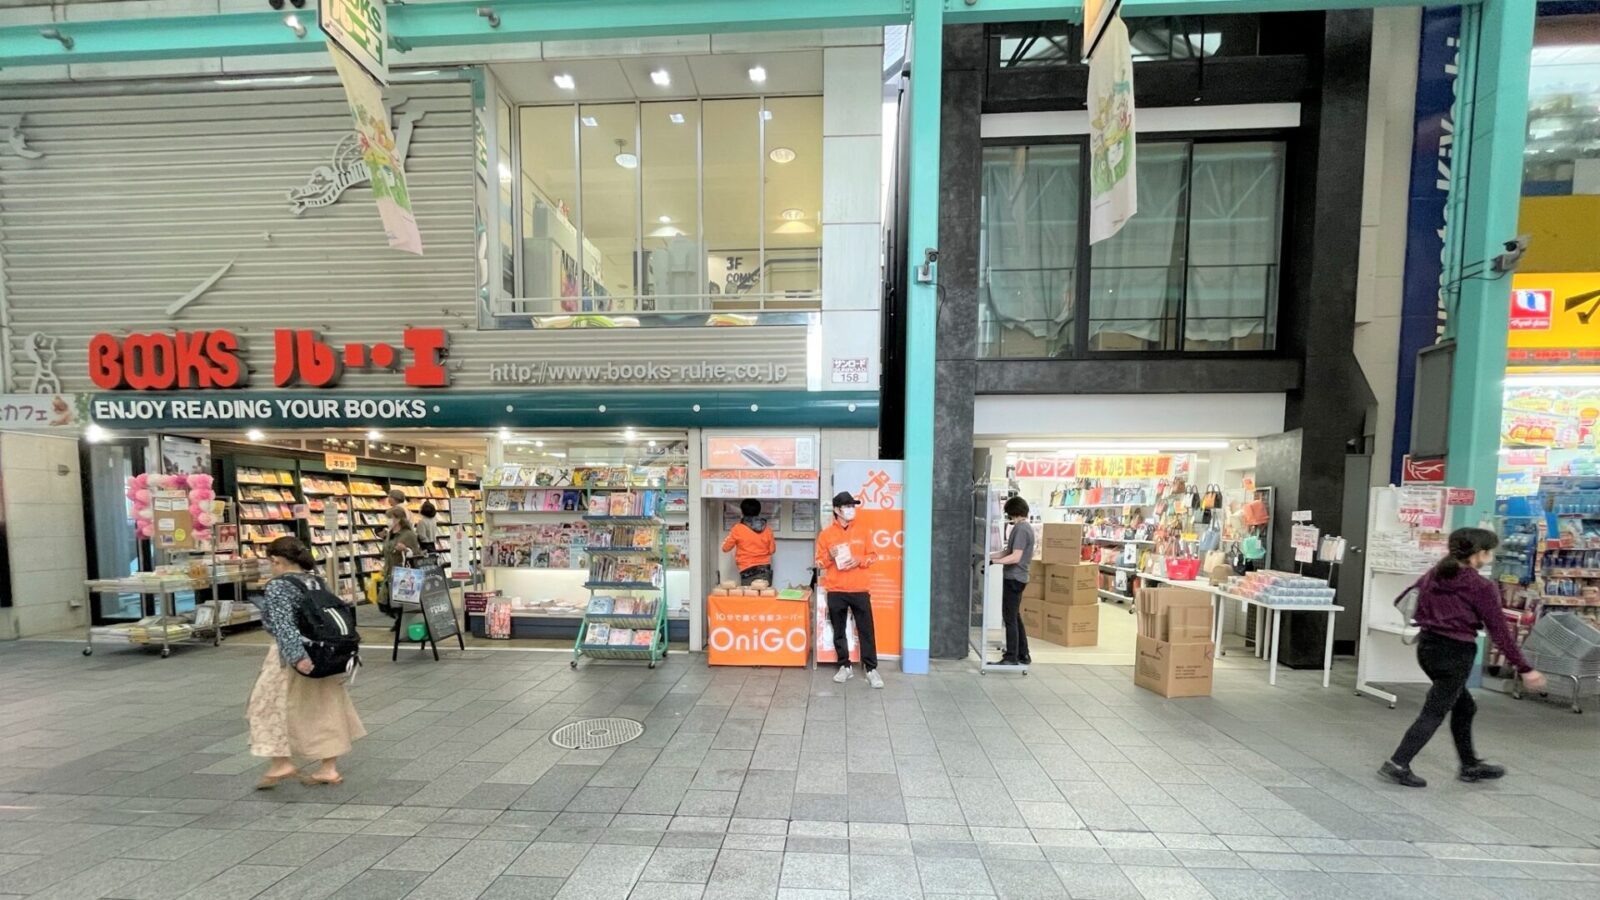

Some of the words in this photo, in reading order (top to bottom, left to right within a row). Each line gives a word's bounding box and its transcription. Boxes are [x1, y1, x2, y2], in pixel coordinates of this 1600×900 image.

[726, 256, 743, 270] 3F
[88, 329, 242, 390] BOOKS
[489, 360, 788, 384] http://www.books-ruhe.co.jp
[841, 373, 859, 382] 158
[94, 400, 167, 419] ENJOY
[171, 399, 272, 419] READING
[276, 399, 342, 419] YOUR
[345, 399, 427, 419] BOOKS
[1079, 457, 1171, 477] 赤札から更に半額
[710, 627, 807, 652] OniGO
